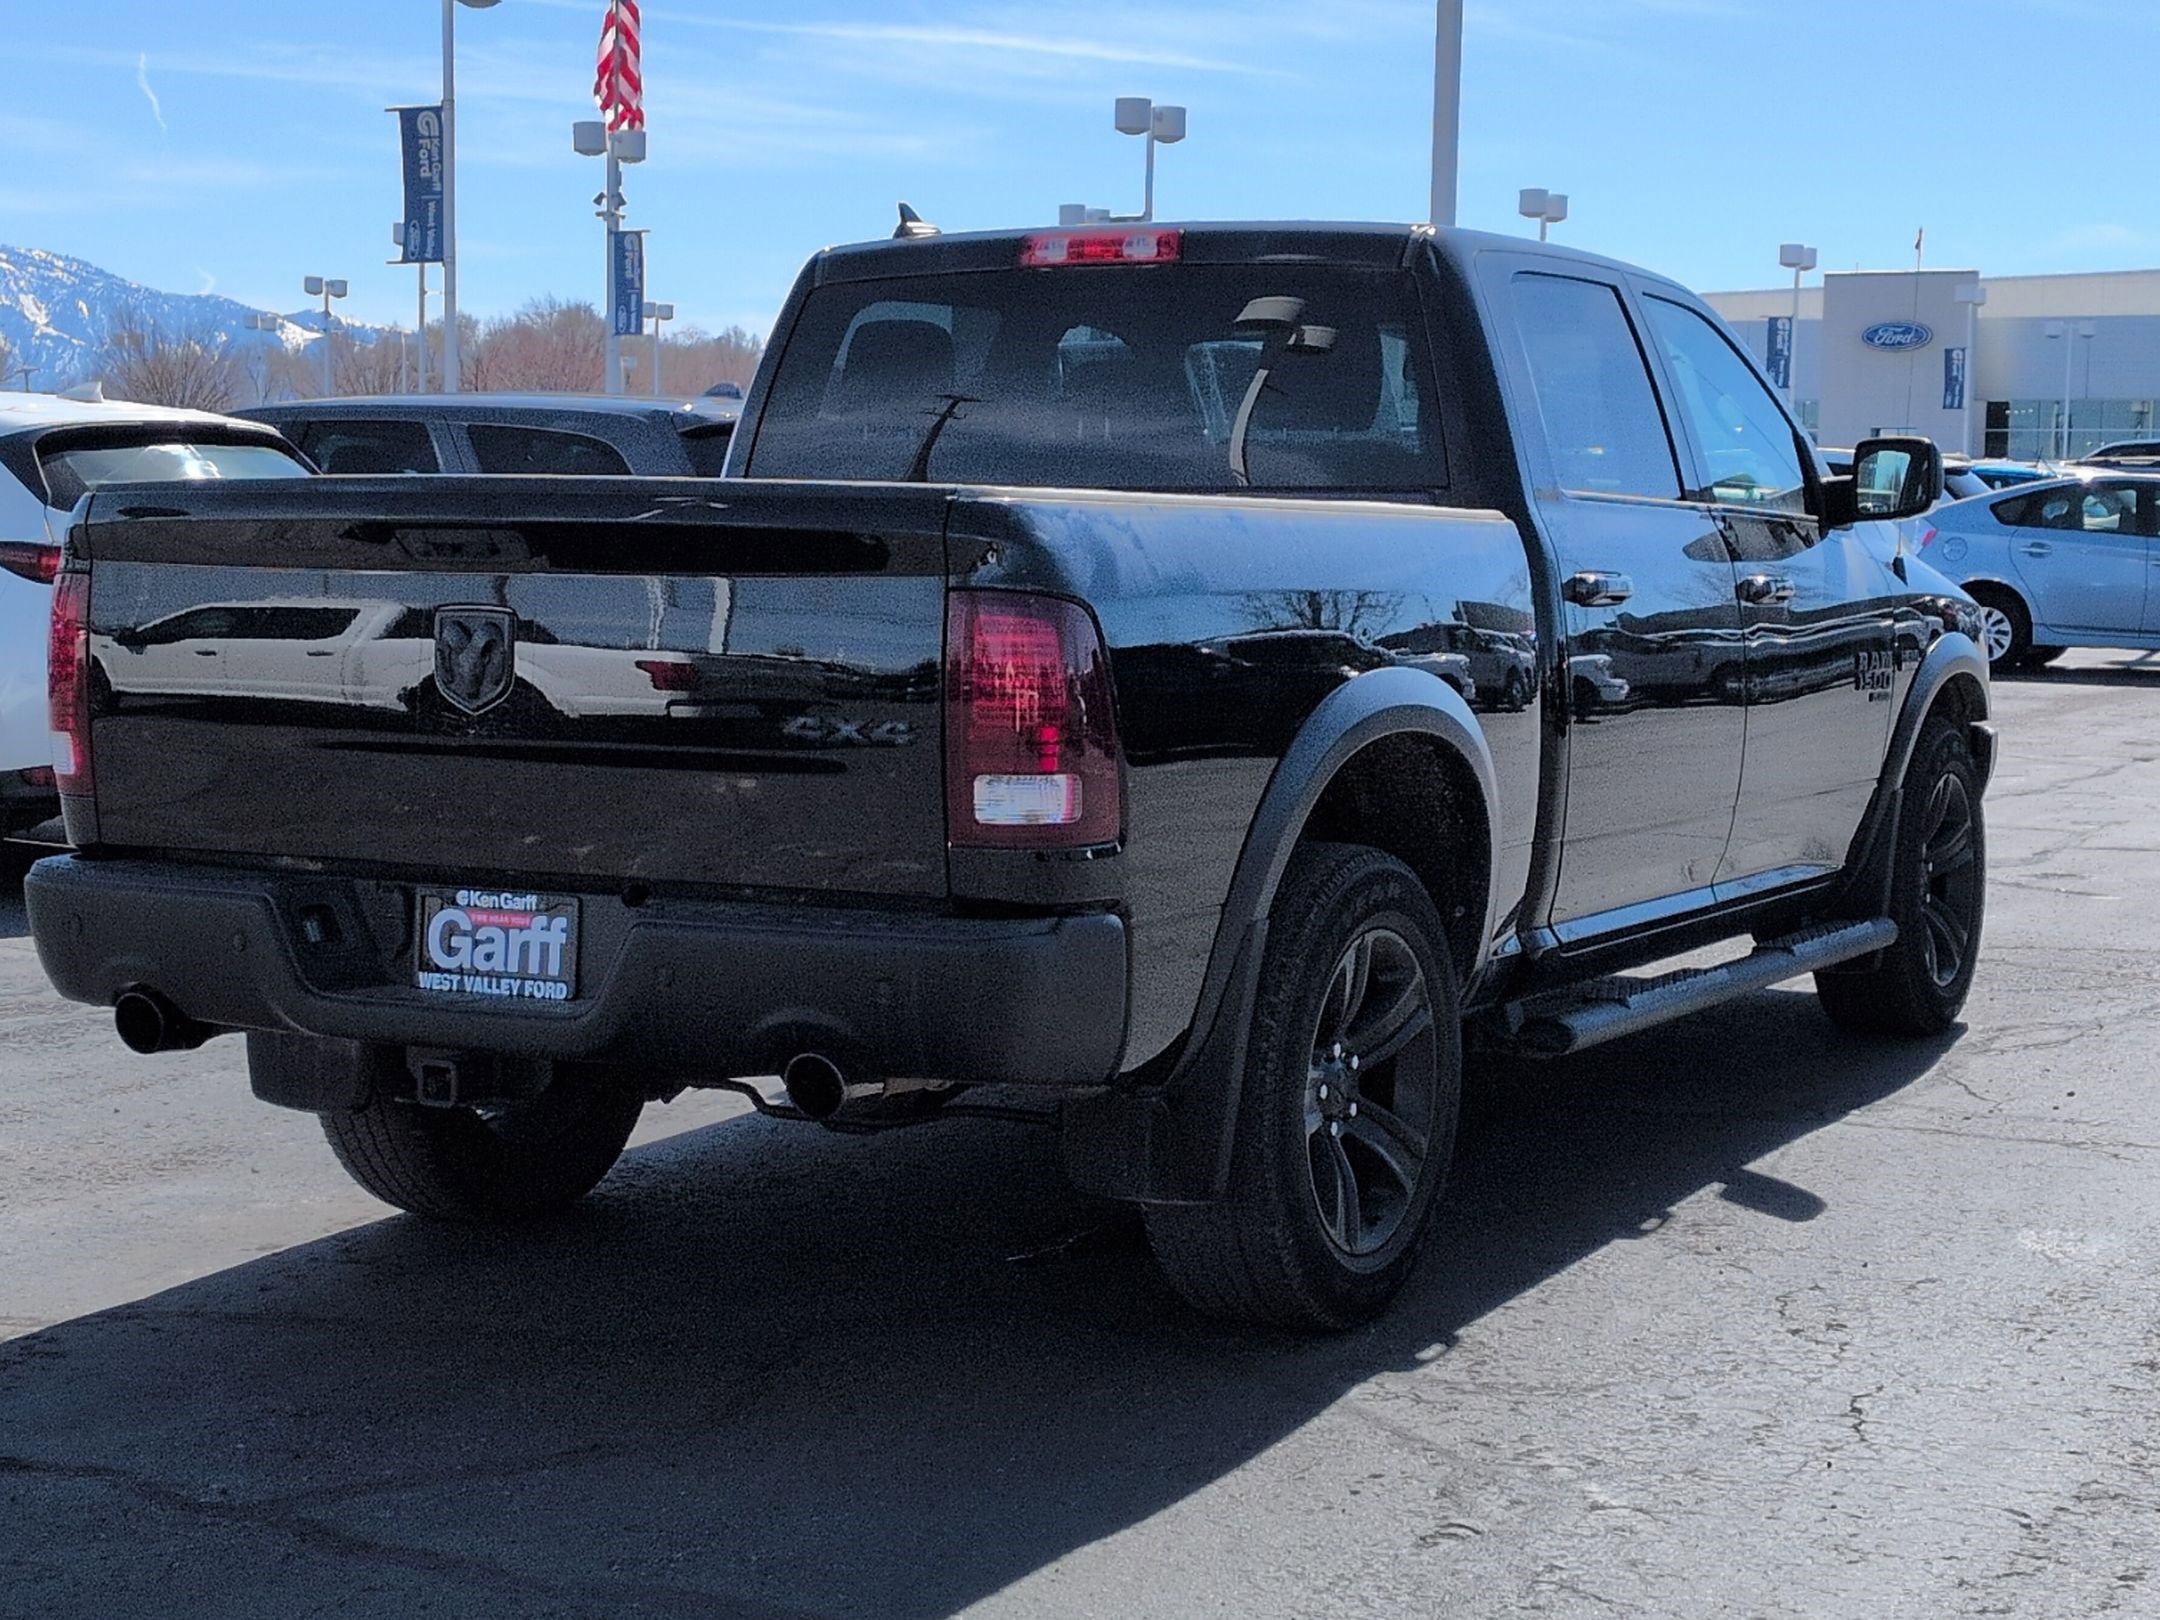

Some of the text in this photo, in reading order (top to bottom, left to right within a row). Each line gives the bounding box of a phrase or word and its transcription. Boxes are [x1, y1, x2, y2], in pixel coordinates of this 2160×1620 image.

[418, 138, 432, 178] Ford
[1857, 651, 1893, 671] RAM
[428, 908, 568, 976] Garff
[418, 971, 568, 1000] WEST VALLEY FORD
